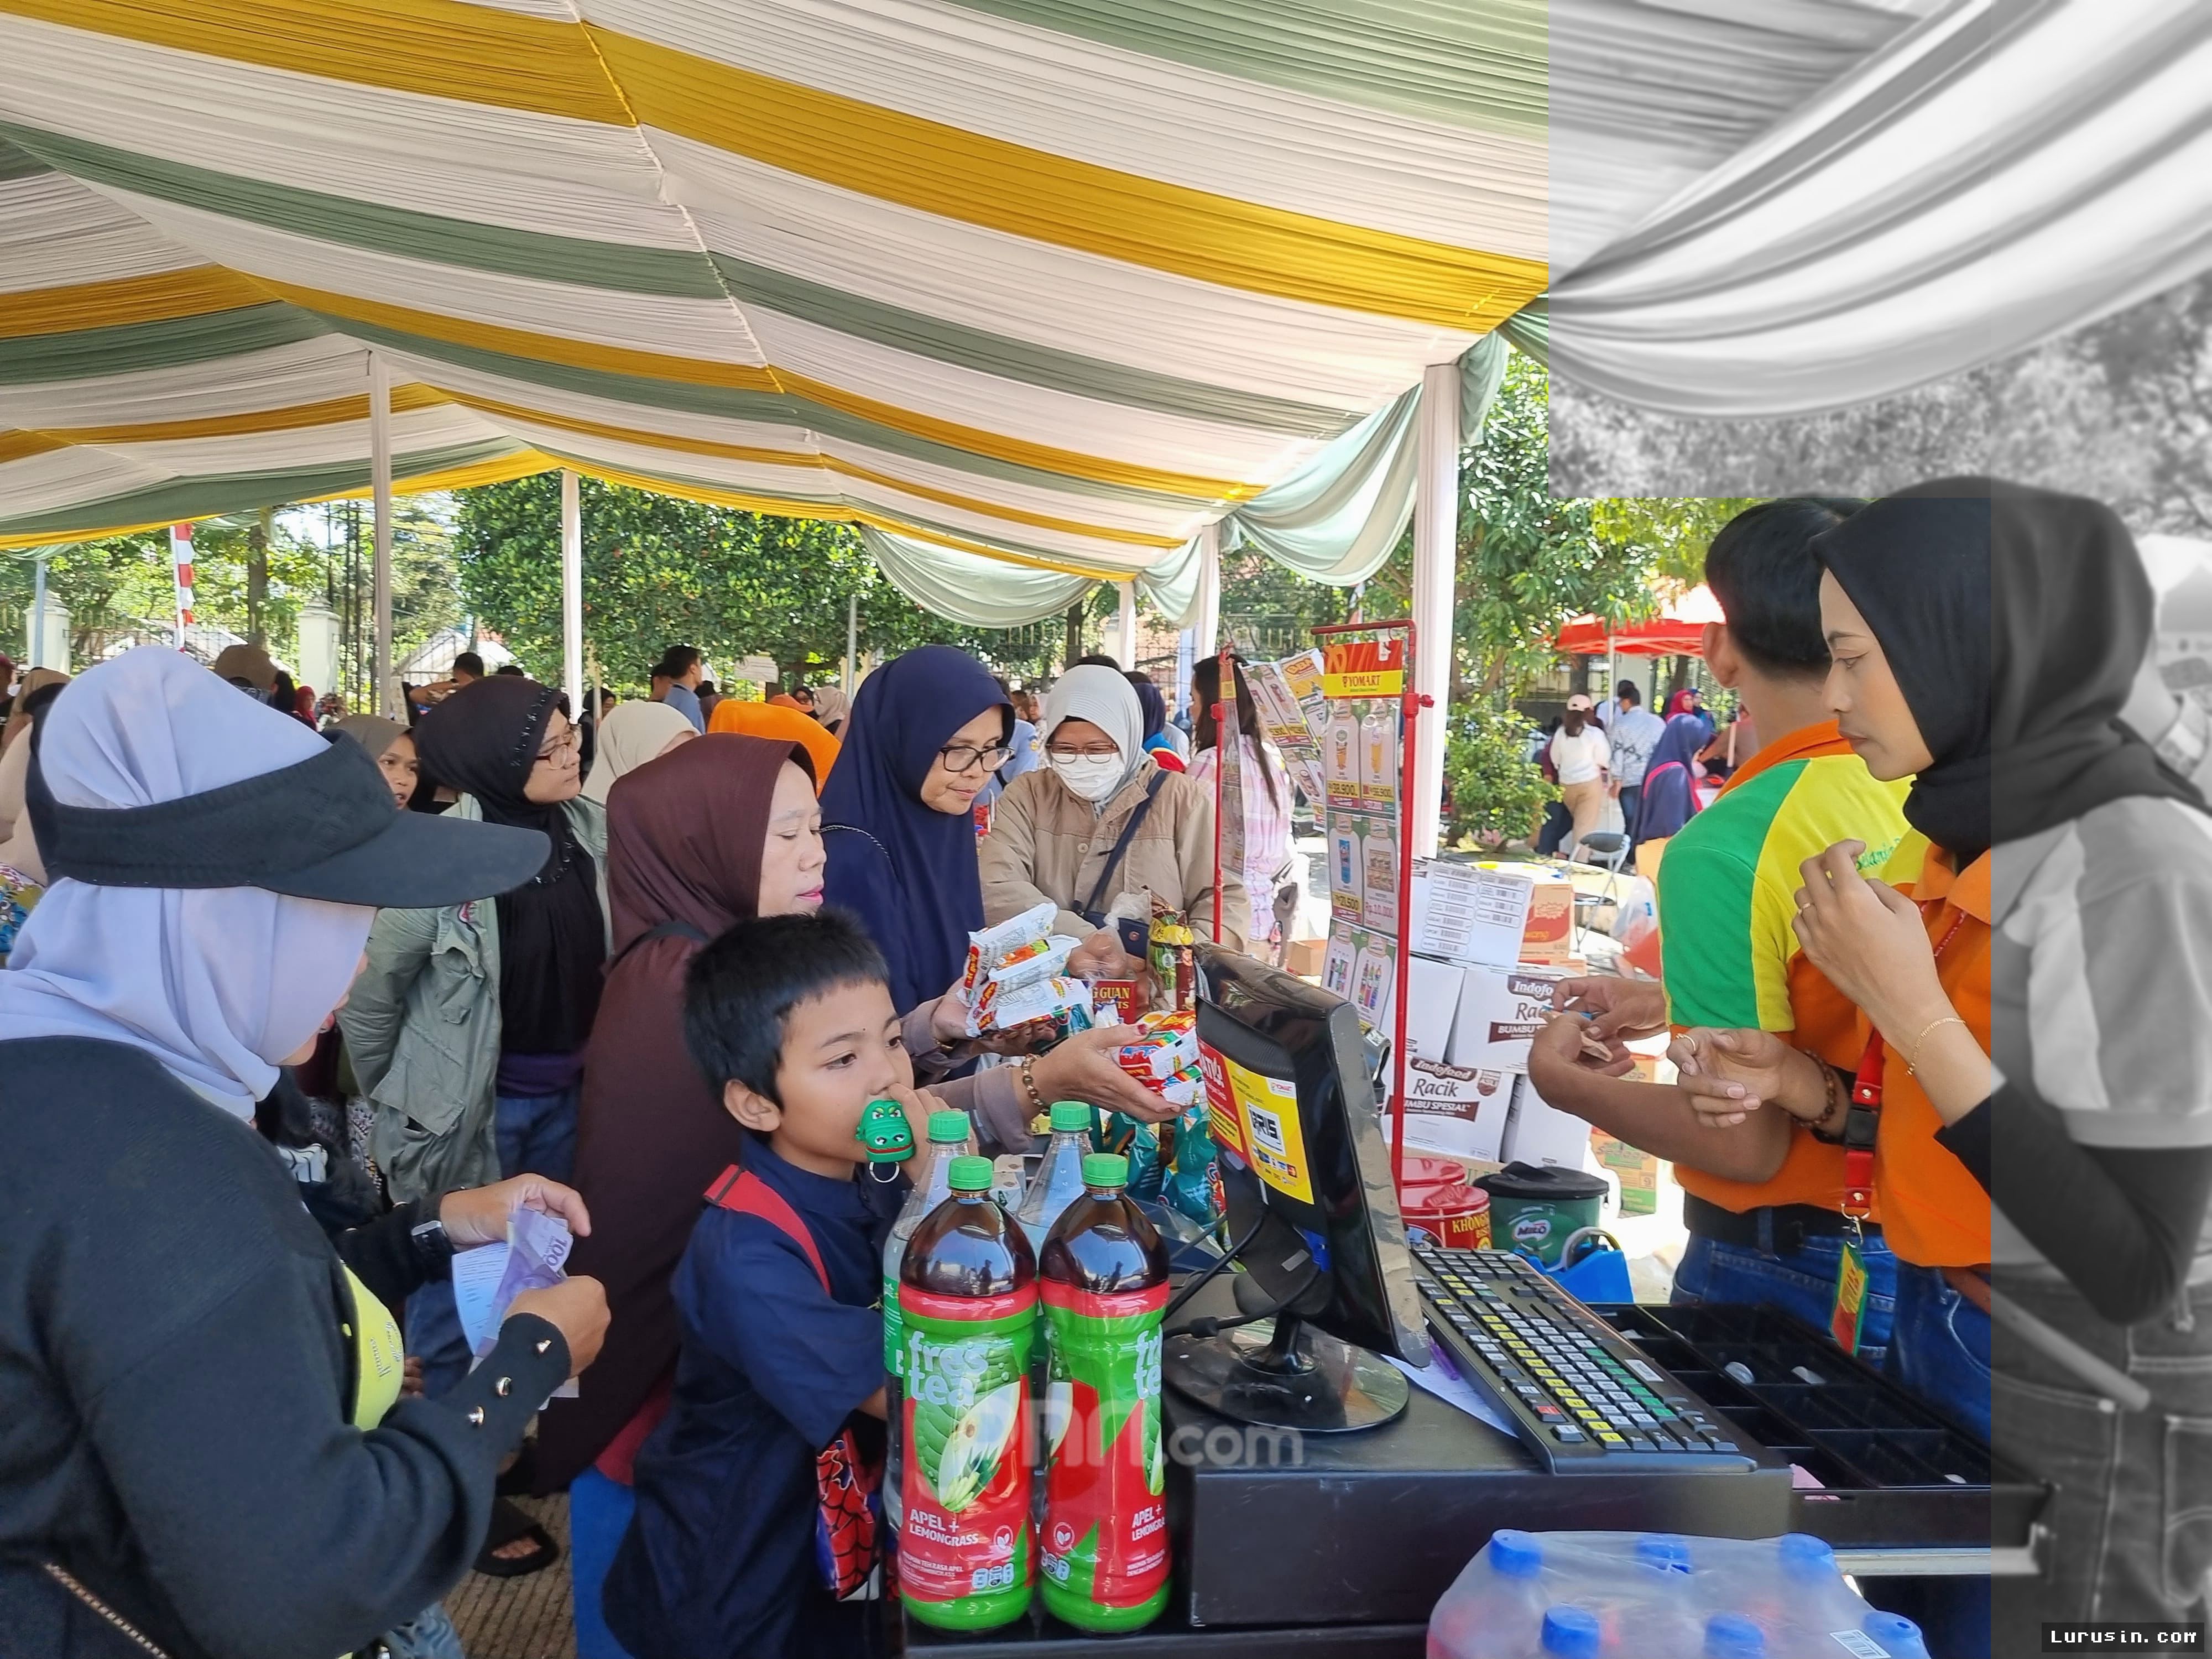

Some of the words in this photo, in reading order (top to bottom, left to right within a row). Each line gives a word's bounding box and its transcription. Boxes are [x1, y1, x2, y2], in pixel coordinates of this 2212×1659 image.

[1349, 675, 1381, 687] YOMART
[1099, 987, 1130, 999] GUAN
[1513, 980, 1554, 998] Indofo
[1415, 1060, 1472, 1079] Indofood
[1413, 1078, 1459, 1098] Racik
[908, 1366, 974, 1407] tea
[910, 1509, 947, 1532] APEL
[1131, 1506, 1155, 1528] APEL
[909, 1523, 979, 1547] LEMONGRASS
